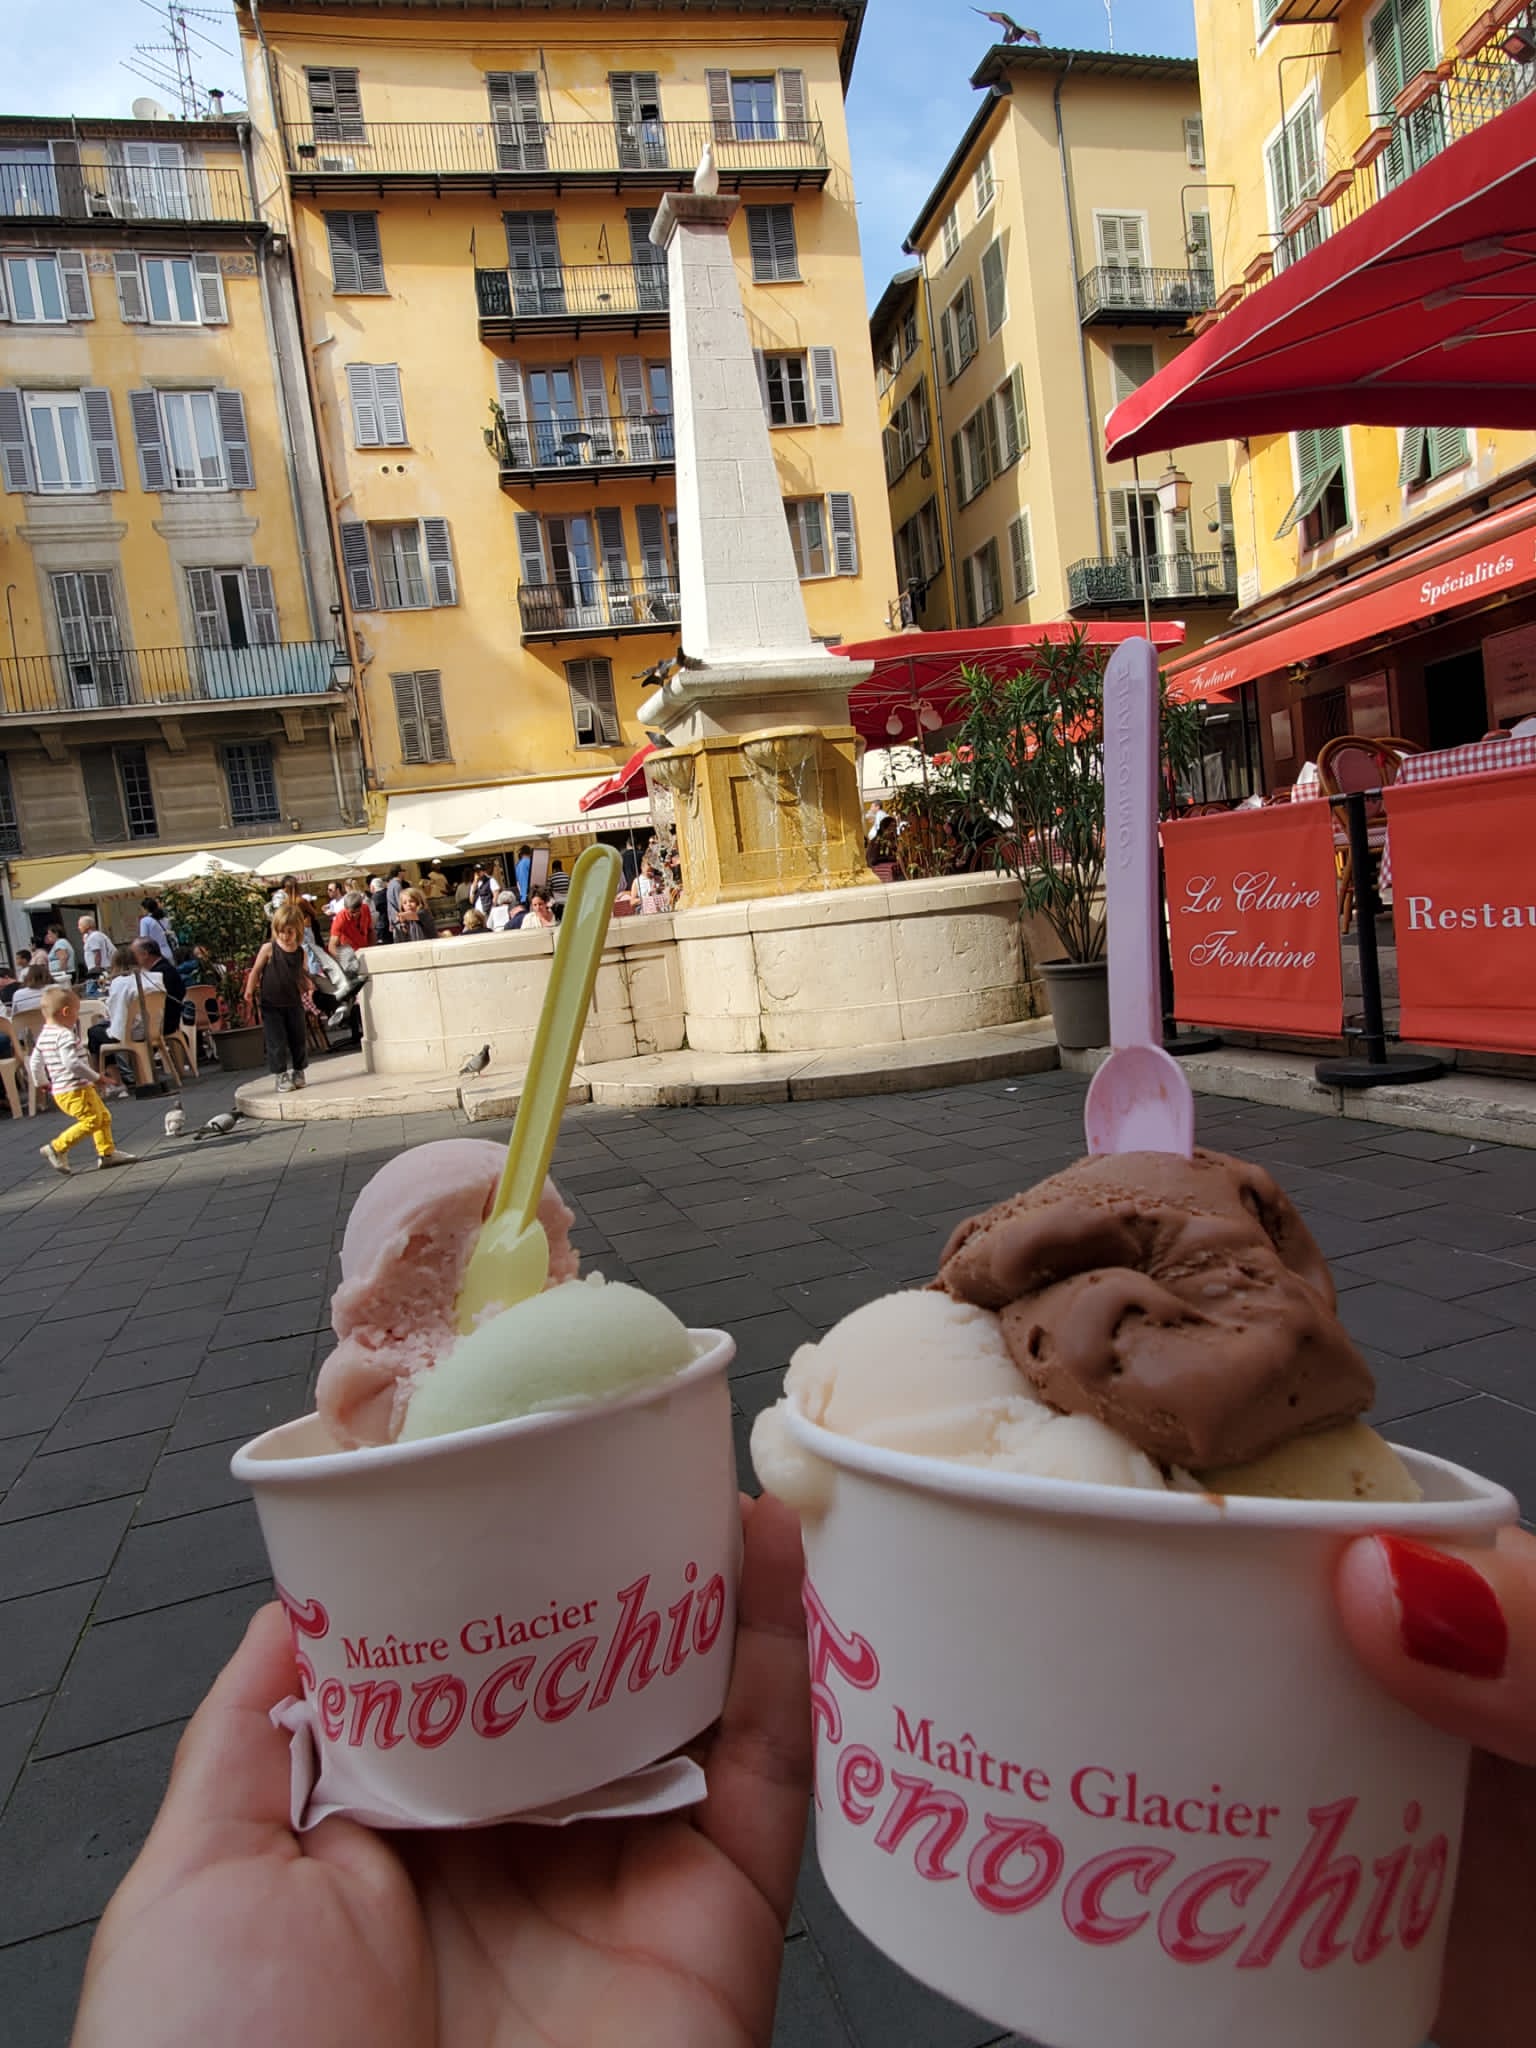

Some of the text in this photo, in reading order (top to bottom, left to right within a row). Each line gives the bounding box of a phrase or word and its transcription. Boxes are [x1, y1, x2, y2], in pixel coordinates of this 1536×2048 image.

[1420, 555, 1515, 605] Spécialités
[1180, 871, 1321, 914] La Claire
[1189, 930, 1317, 969] Fontaine
[341, 1600, 599, 1670] Maître Glacier
[893, 1704, 1281, 1840] Maître Glacier
